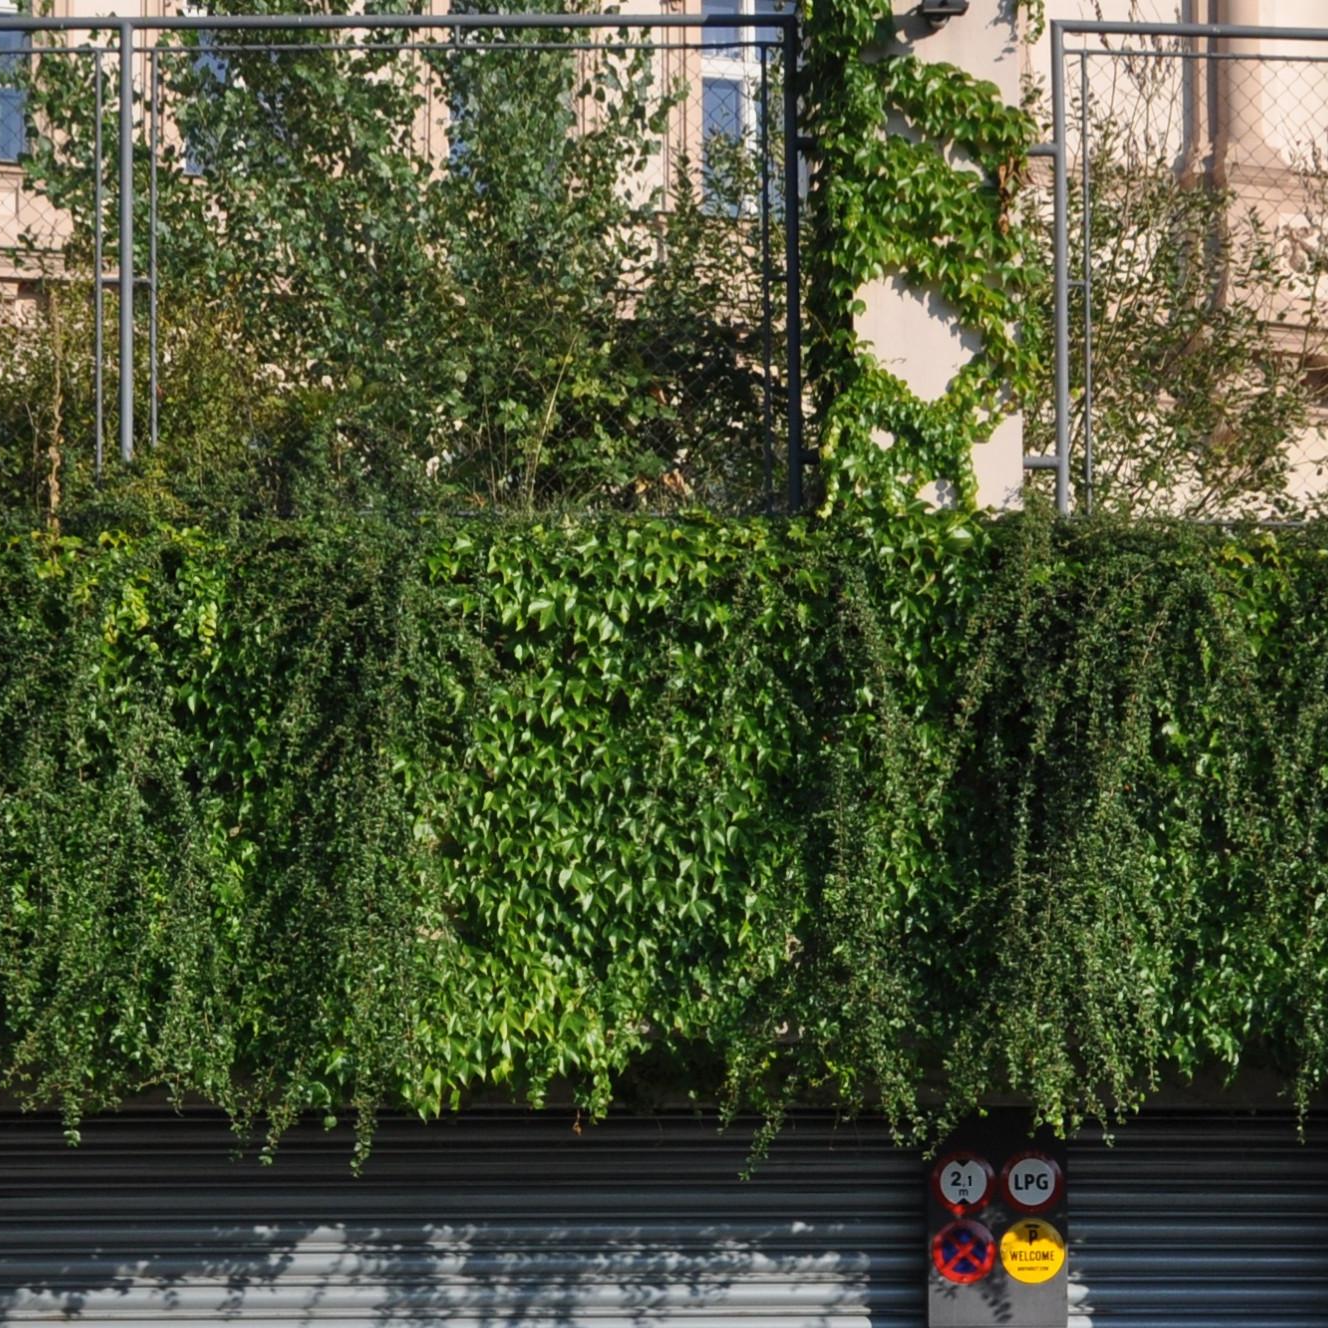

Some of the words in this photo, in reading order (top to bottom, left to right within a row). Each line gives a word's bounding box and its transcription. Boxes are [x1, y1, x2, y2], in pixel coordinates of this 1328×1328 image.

[1014, 1174, 1049, 1190] LPG
[1029, 1230, 1038, 1246] P
[1009, 1250, 1055, 1262] WELCOME
